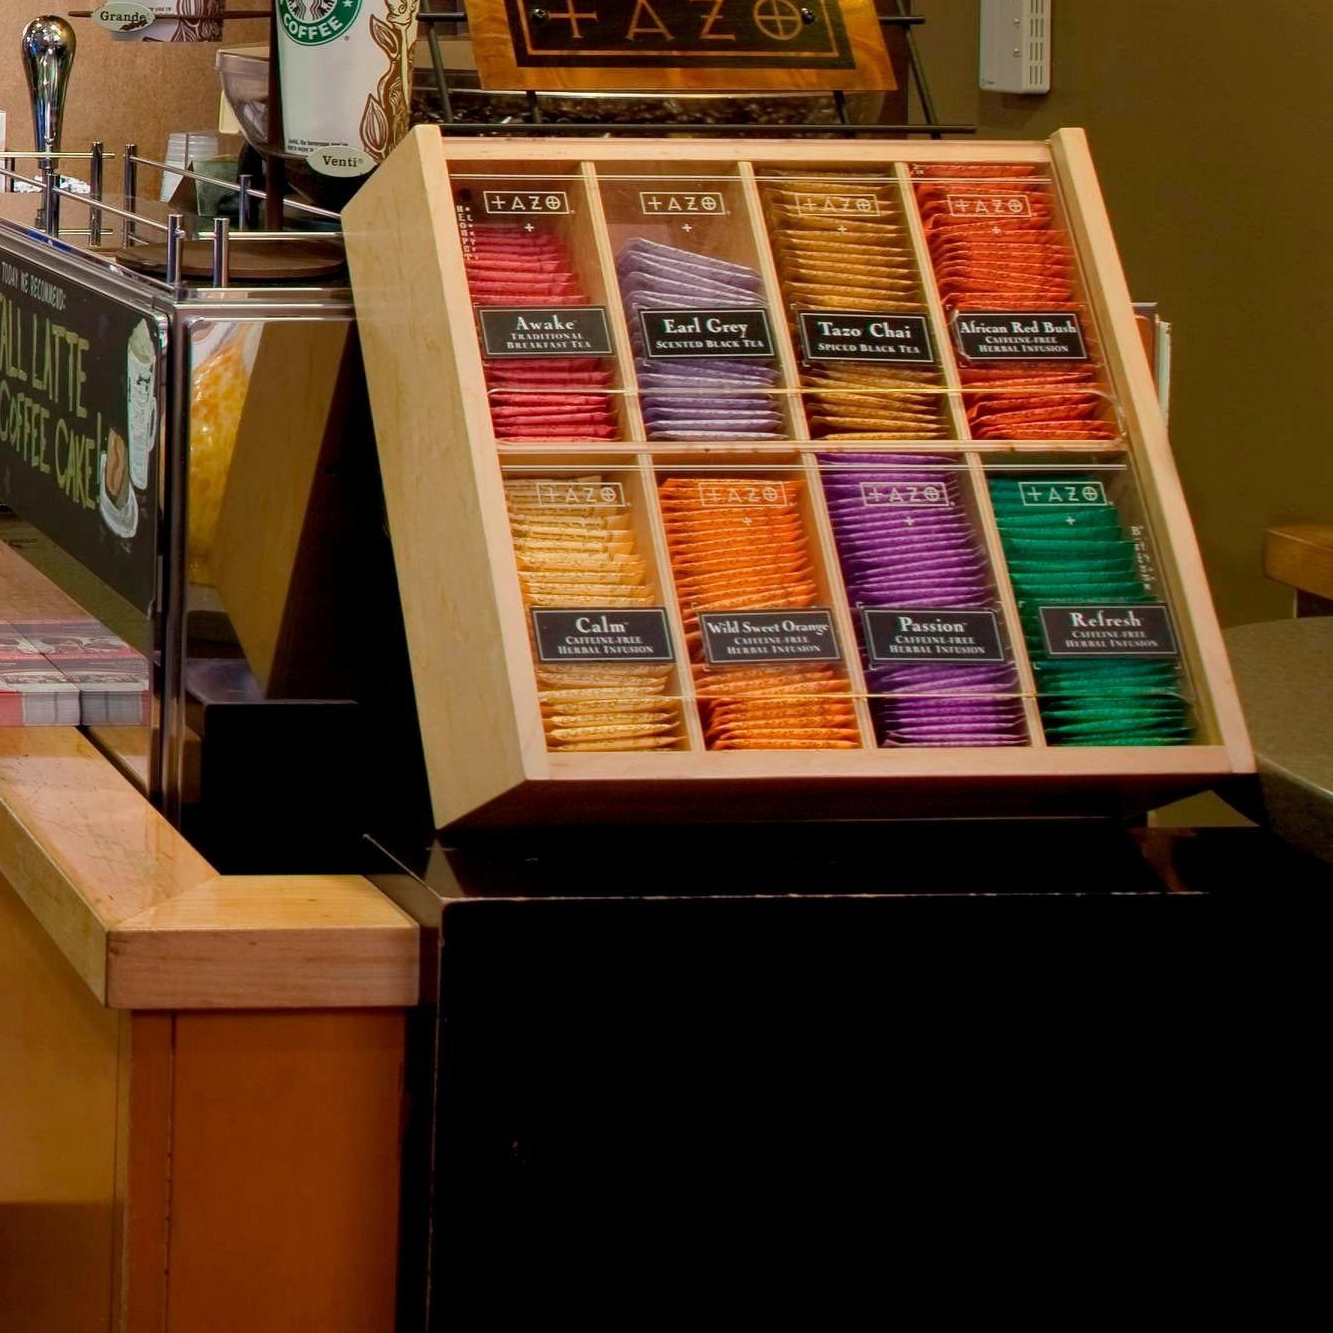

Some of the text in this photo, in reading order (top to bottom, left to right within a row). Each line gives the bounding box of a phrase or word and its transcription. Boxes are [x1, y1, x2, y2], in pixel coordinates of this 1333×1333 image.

[99, 10, 147, 22] Grande
[323, 155, 357, 167] Venti
[516, 315, 574, 332] Awake
[663, 318, 747, 338] Earl Grey
[819, 322, 911, 339] Tazo Chai
[960, 321, 1075, 335] African Red Bush
[507, 340, 591, 349] BREAKFAST TEA
[511, 332, 584, 341] TRADITIONAL
[33, 313, 90, 419] LATTE
[55, 412, 102, 511] CAKE!
[575, 616, 624, 634] Calm
[900, 617, 964, 635] Passion
[1071, 612, 1141, 628] Refresh
[707, 621, 829, 637] Wild Sweet Orange
